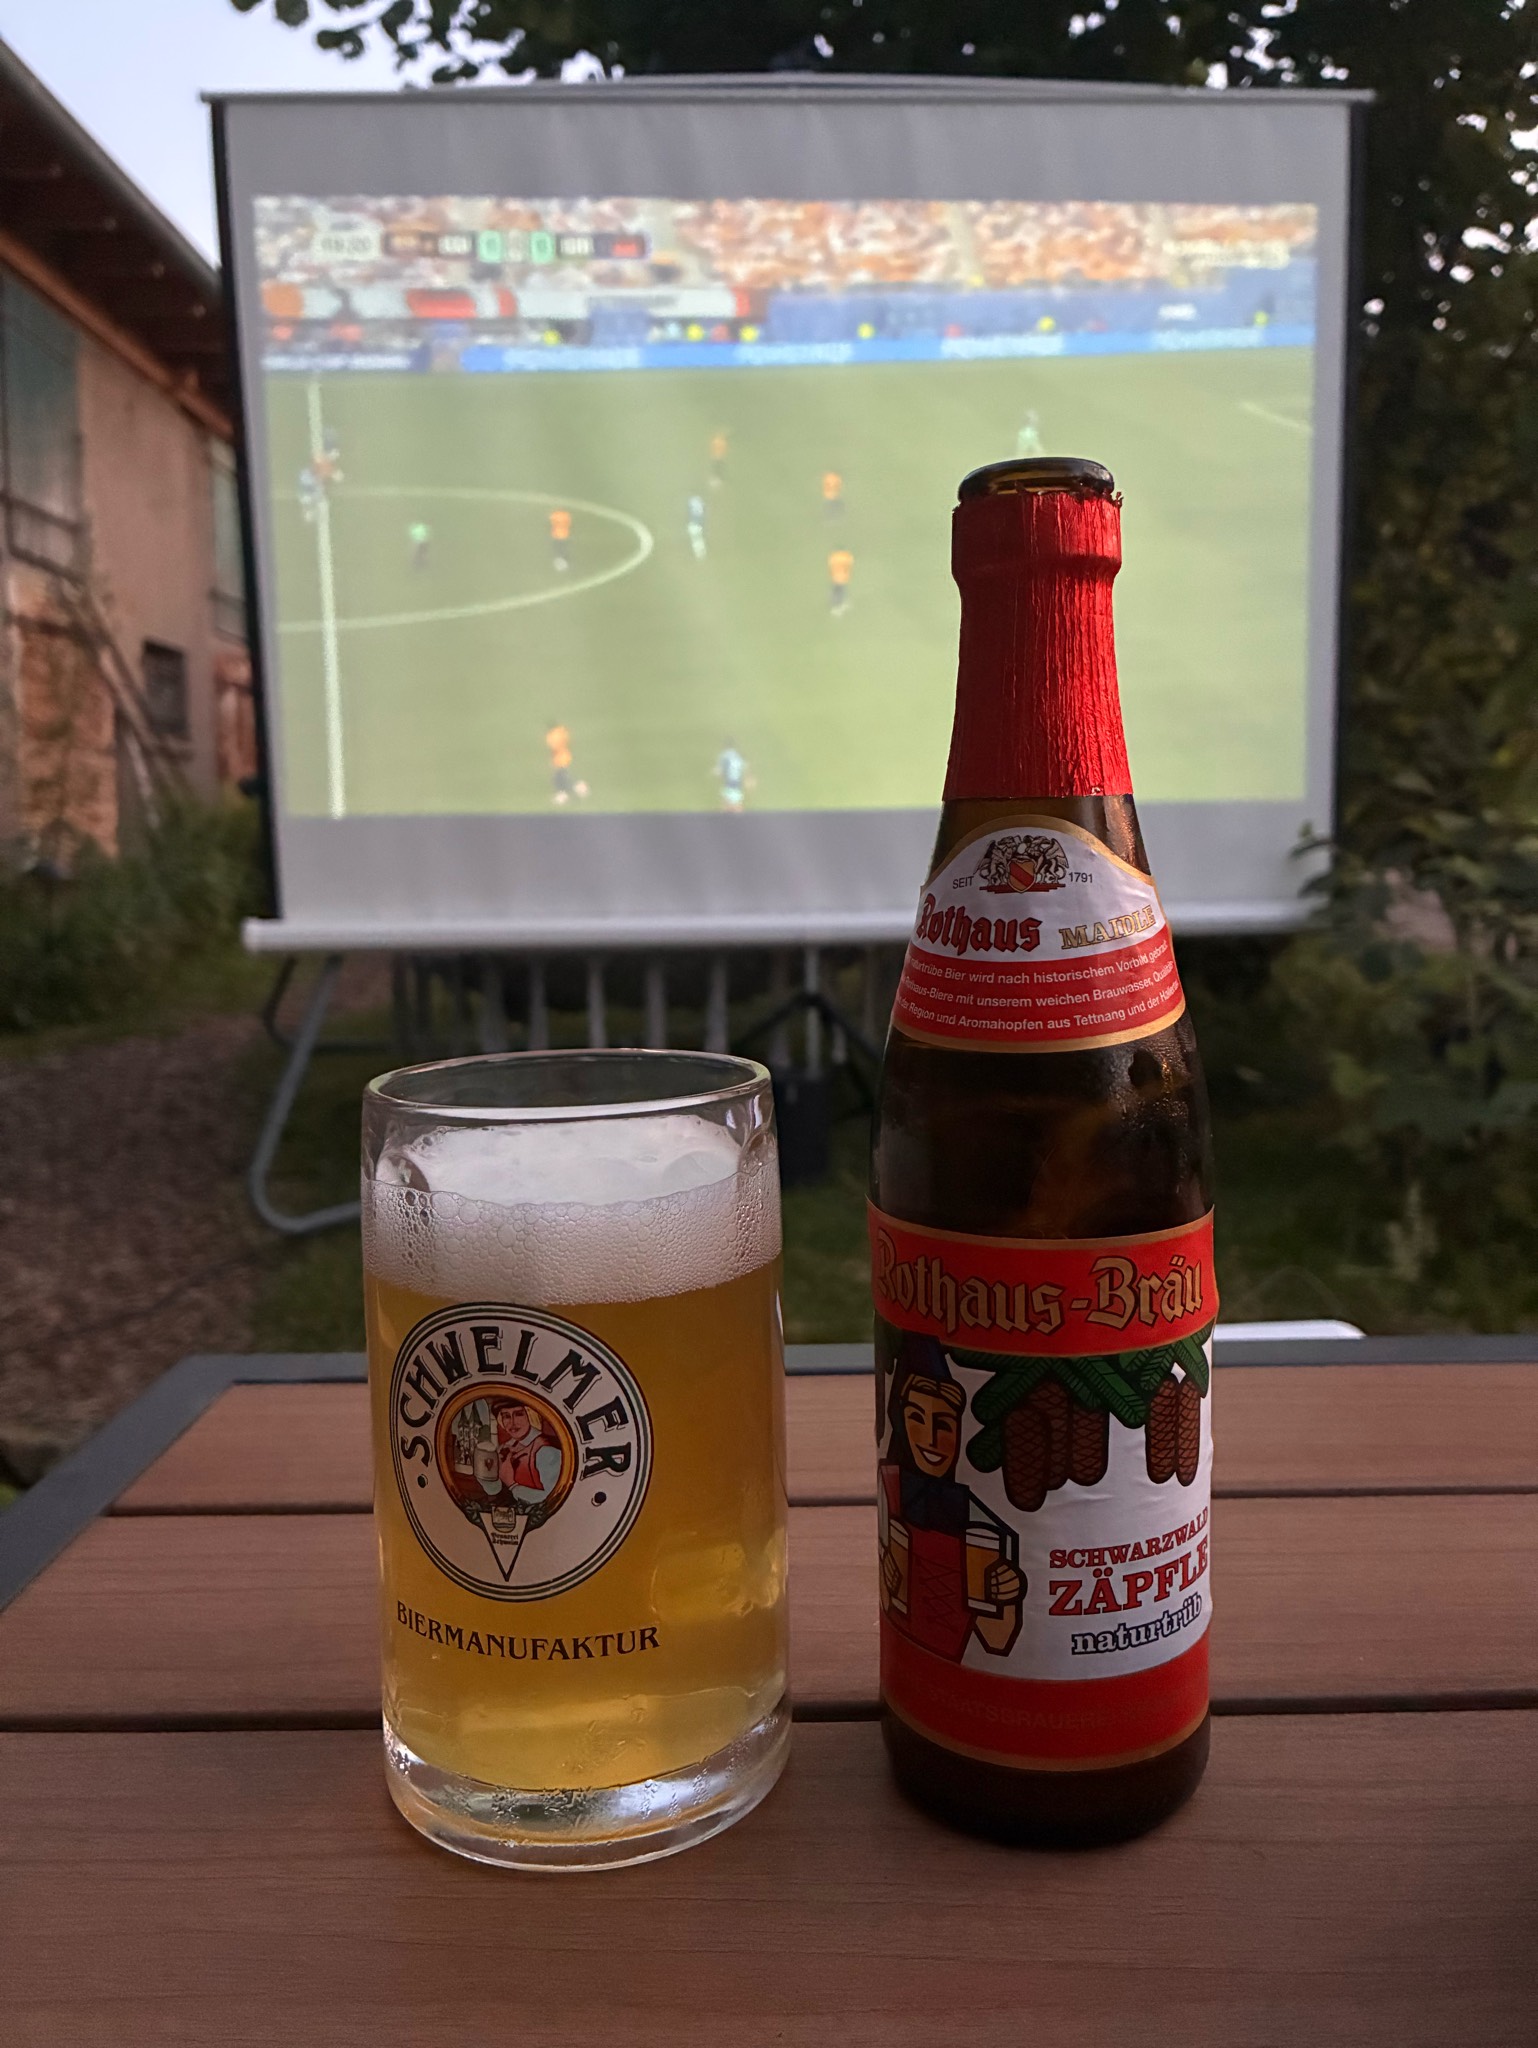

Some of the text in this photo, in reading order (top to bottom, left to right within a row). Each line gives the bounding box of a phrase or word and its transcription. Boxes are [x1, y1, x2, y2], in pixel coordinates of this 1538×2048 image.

[952, 876, 974, 890] SEIT
[1068, 871, 1093, 885] 1791
[916, 893, 1043, 956] Rothaus
[1058, 904, 1157, 950] MAIDLE
[944, 967, 966, 981] Bier
[968, 972, 994, 985] wird
[997, 972, 1030, 985] nach
[1033, 965, 1115, 985] historischem
[1115, 954, 1149, 973] Vorbild
[955, 993, 974, 1006] mit
[976, 997, 1032, 1008] unserem
[1035, 993, 1091, 1007] weichen
[1092, 976, 1154, 1001] Brauwasser,
[908, 1002, 935, 1021] Region
[936, 1012, 956, 1026] und
[957, 1015, 1044, 1032] Aromahopfen
[1046, 1018, 1071, 1030] aus
[1073, 1008, 1126, 1027] Tettnang
[1127, 1000, 1147, 1017] und
[1147, 995, 1161, 1009] der
[399, 1324, 633, 1482] SCHWELMER
[1049, 1504, 1209, 1570] SCHWARZWALD
[1048, 1534, 1209, 1617] ZÄPFLE
[397, 1600, 661, 1663] BIERMANUFAKTUR
[1071, 1592, 1203, 1656] naturtrüb
